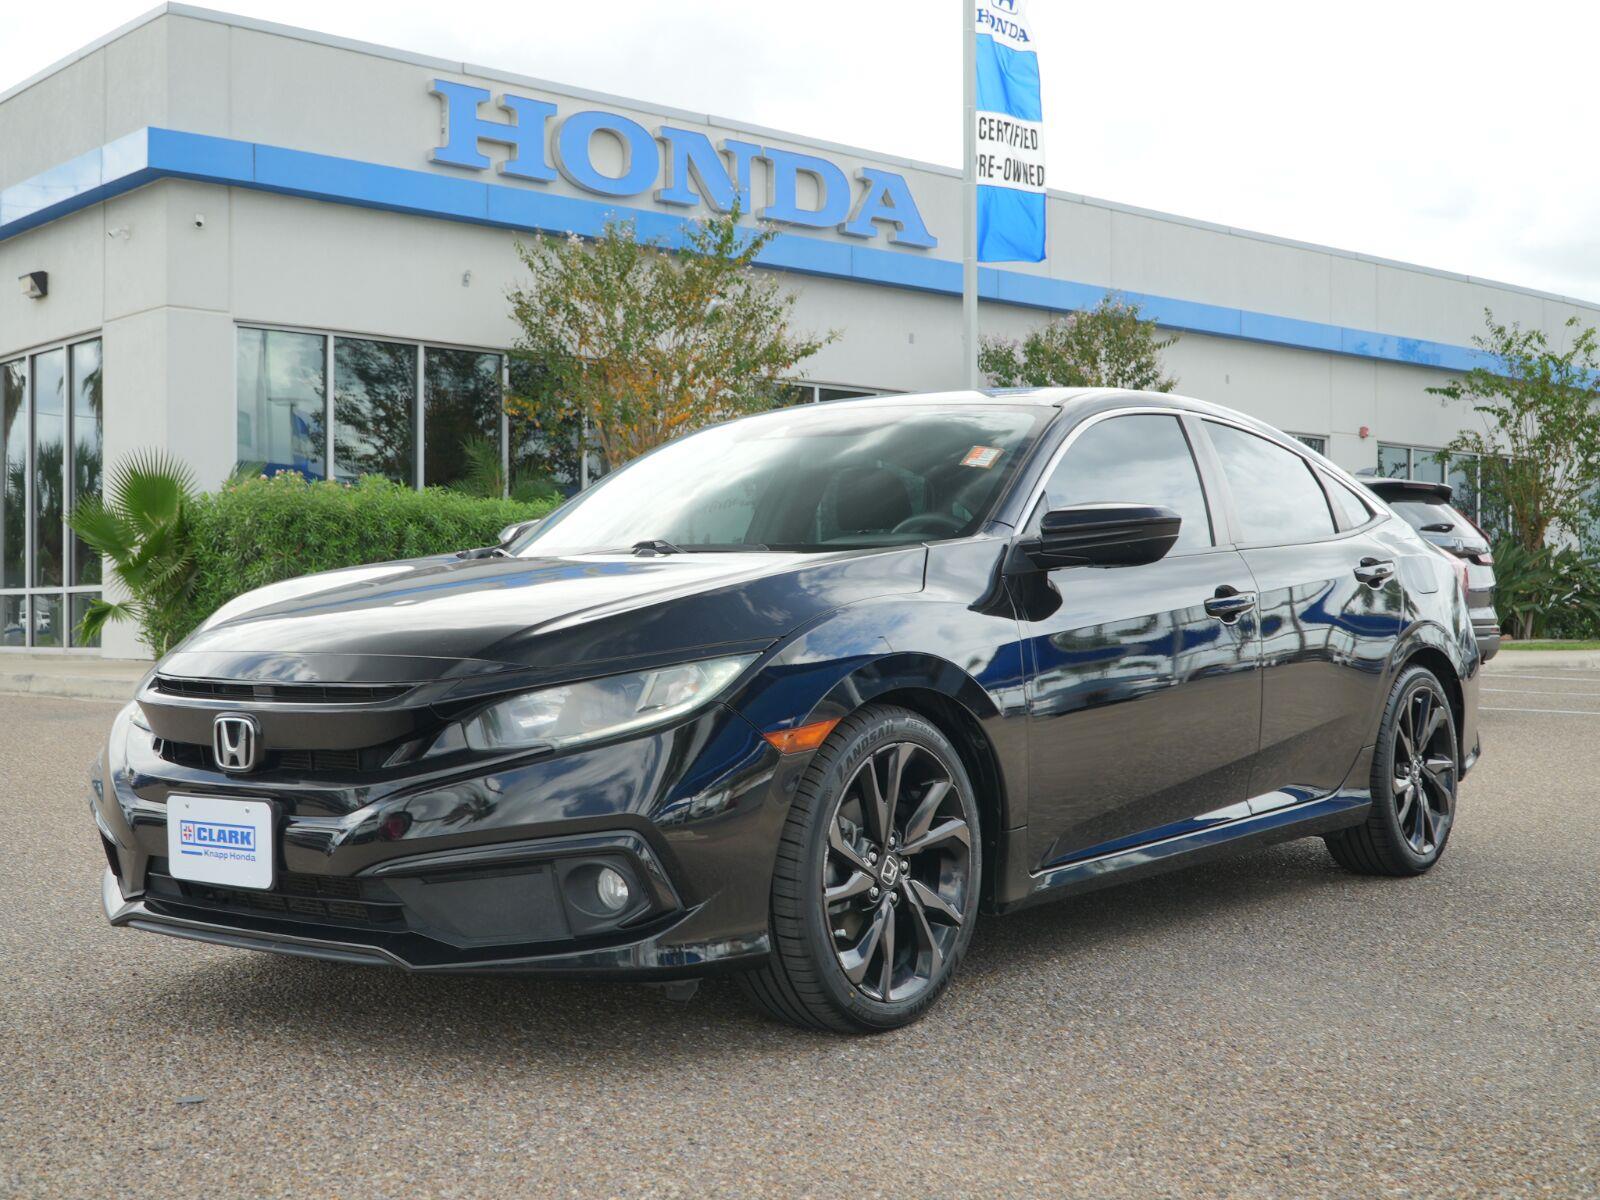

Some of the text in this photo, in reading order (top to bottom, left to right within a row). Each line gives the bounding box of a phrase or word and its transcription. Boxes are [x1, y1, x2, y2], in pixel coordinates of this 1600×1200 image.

[976, 8, 1030, 42] HONDA
[979, 117, 1038, 150] CERTIFIED
[428, 78, 937, 249] HONDA
[976, 154, 1045, 187] RE-OWNED
[197, 827, 252, 846] CLARK
[203, 850, 256, 862] Knapp Honda
